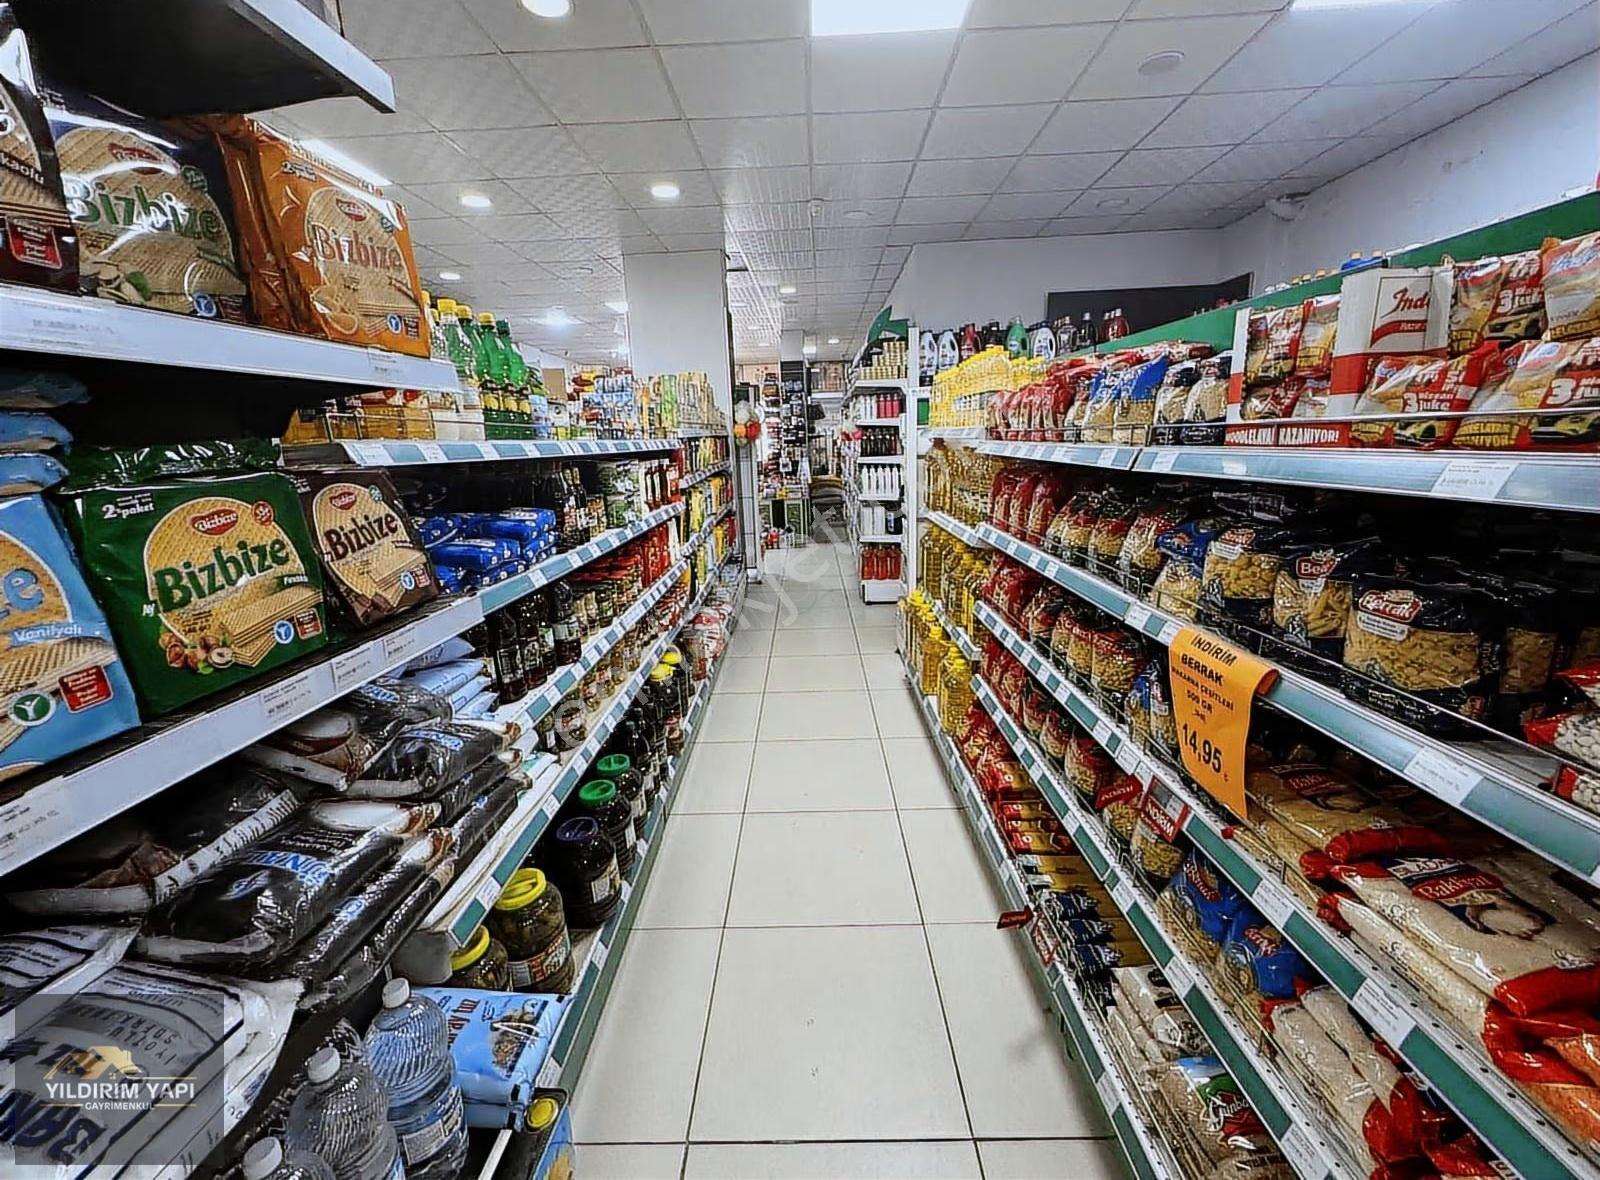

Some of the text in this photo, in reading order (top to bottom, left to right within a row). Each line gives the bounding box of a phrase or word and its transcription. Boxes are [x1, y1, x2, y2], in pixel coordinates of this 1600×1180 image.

[62, 176, 220, 242] Bizbize
[312, 222, 402, 272] Bizbize
[1403, 392, 1419, 412] 3
[1546, 378, 1577, 404] 3
[122, 500, 155, 519] paket
[323, 512, 399, 562] Bizbize
[153, 538, 290, 614] Bizbize
[1362, 593, 1414, 618] Berrak
[1190, 634, 1238, 668] İNDİRİM
[1181, 653, 1225, 687] BERRAK
[1182, 722, 1222, 774] 14,95
